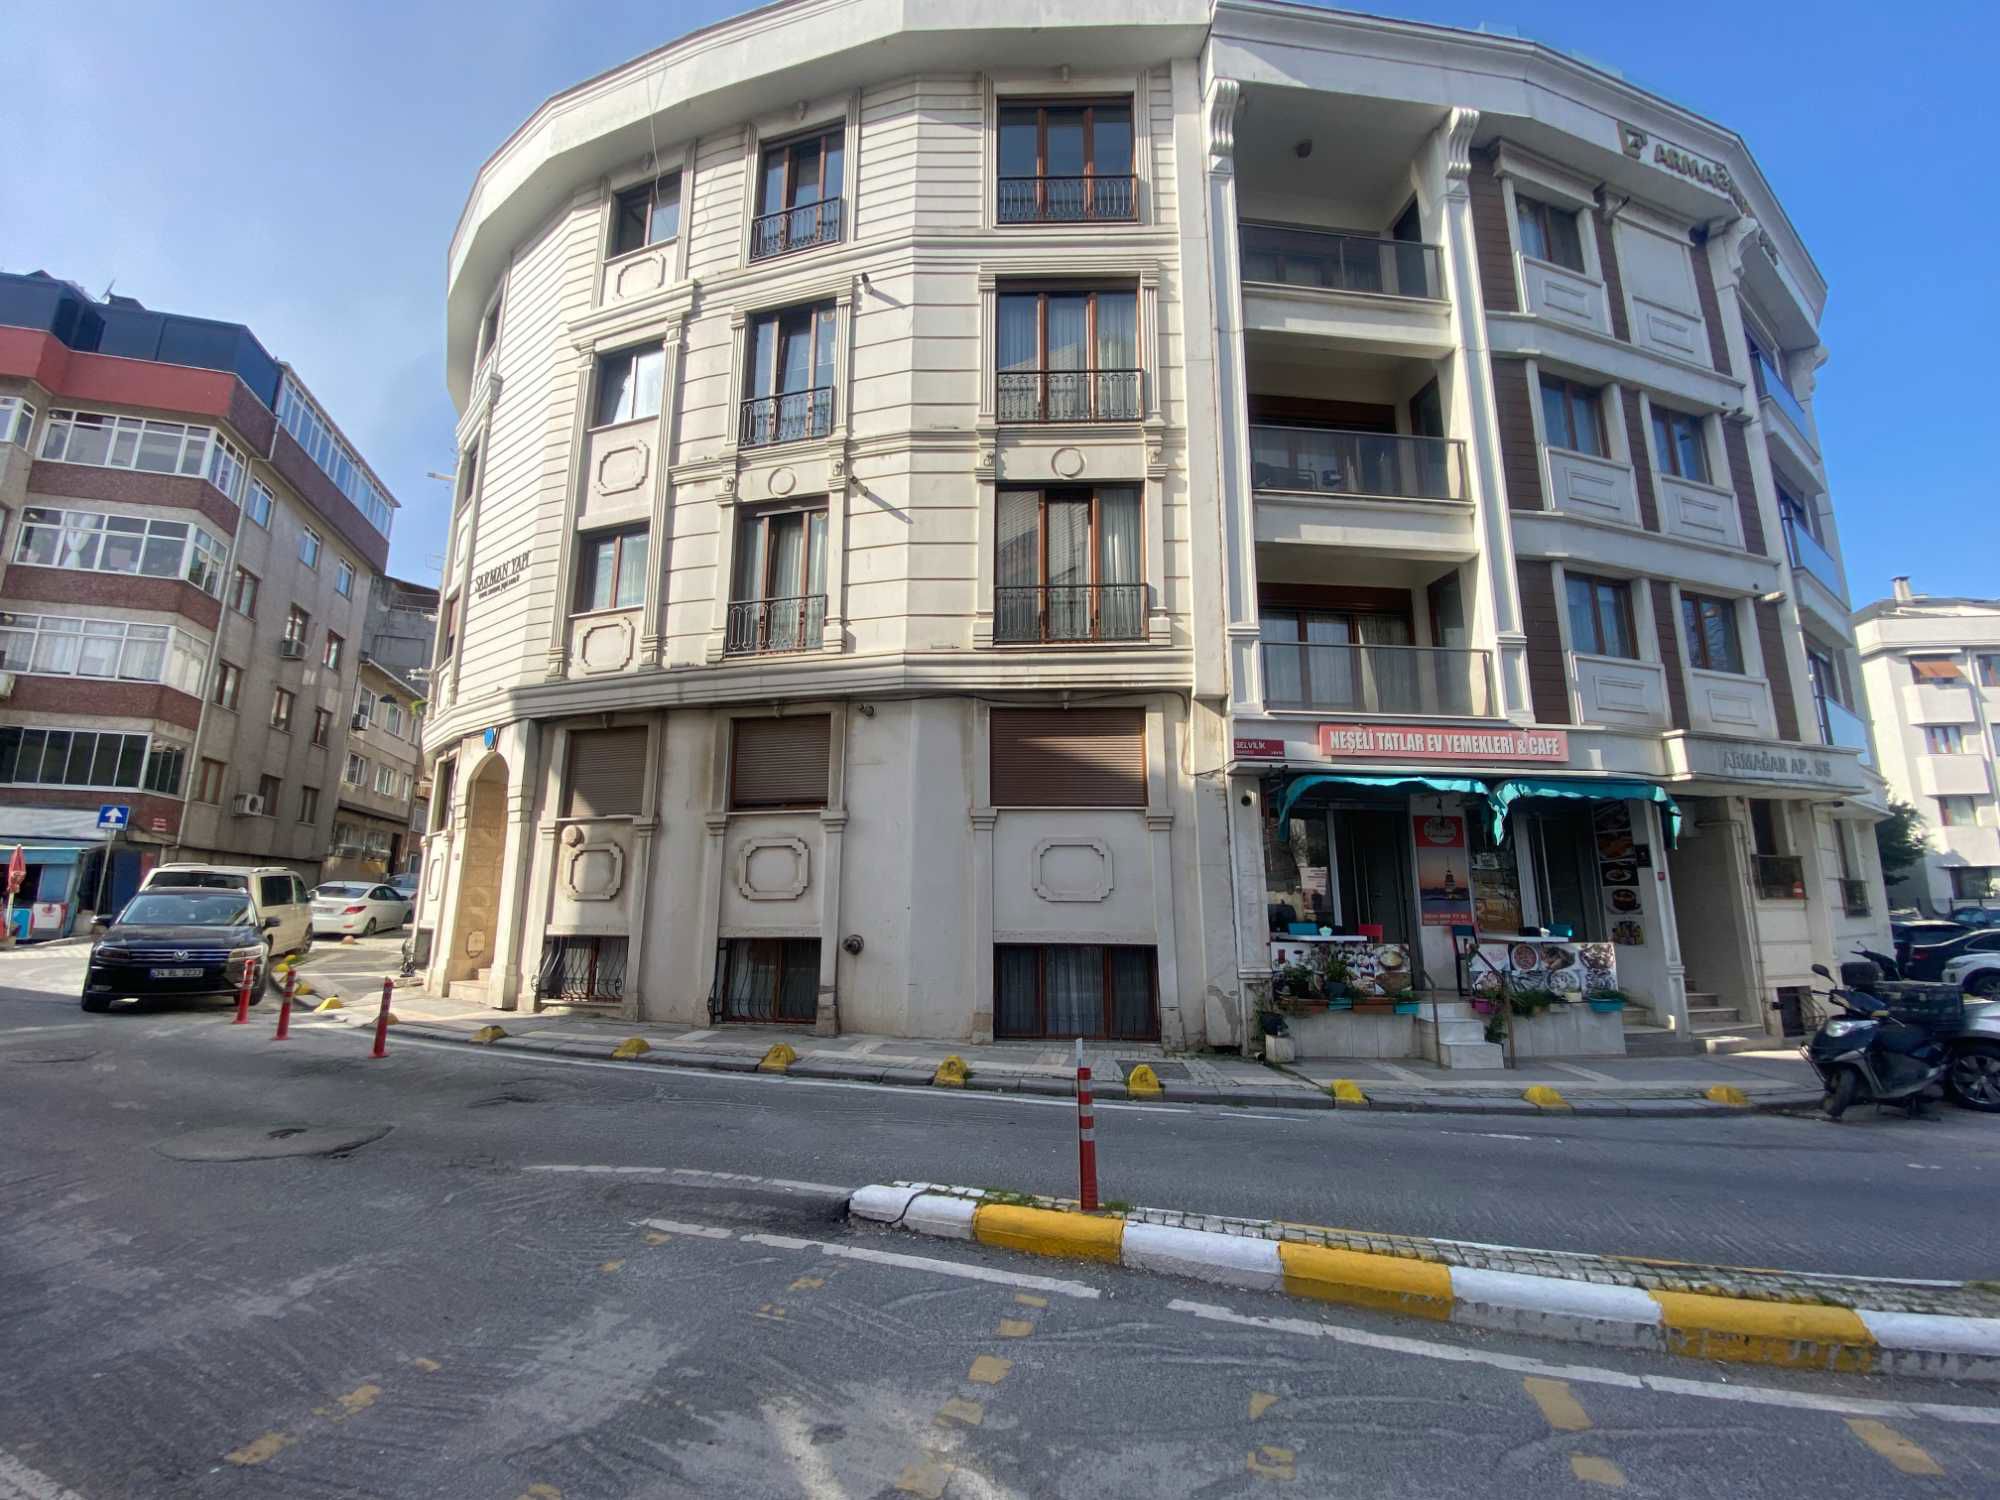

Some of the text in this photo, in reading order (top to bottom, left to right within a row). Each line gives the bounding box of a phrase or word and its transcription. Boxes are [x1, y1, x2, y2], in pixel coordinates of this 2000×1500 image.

[1329, 727, 1560, 756] NEŞELİ TATLAR EV YEMEKLERİ & CAFE
